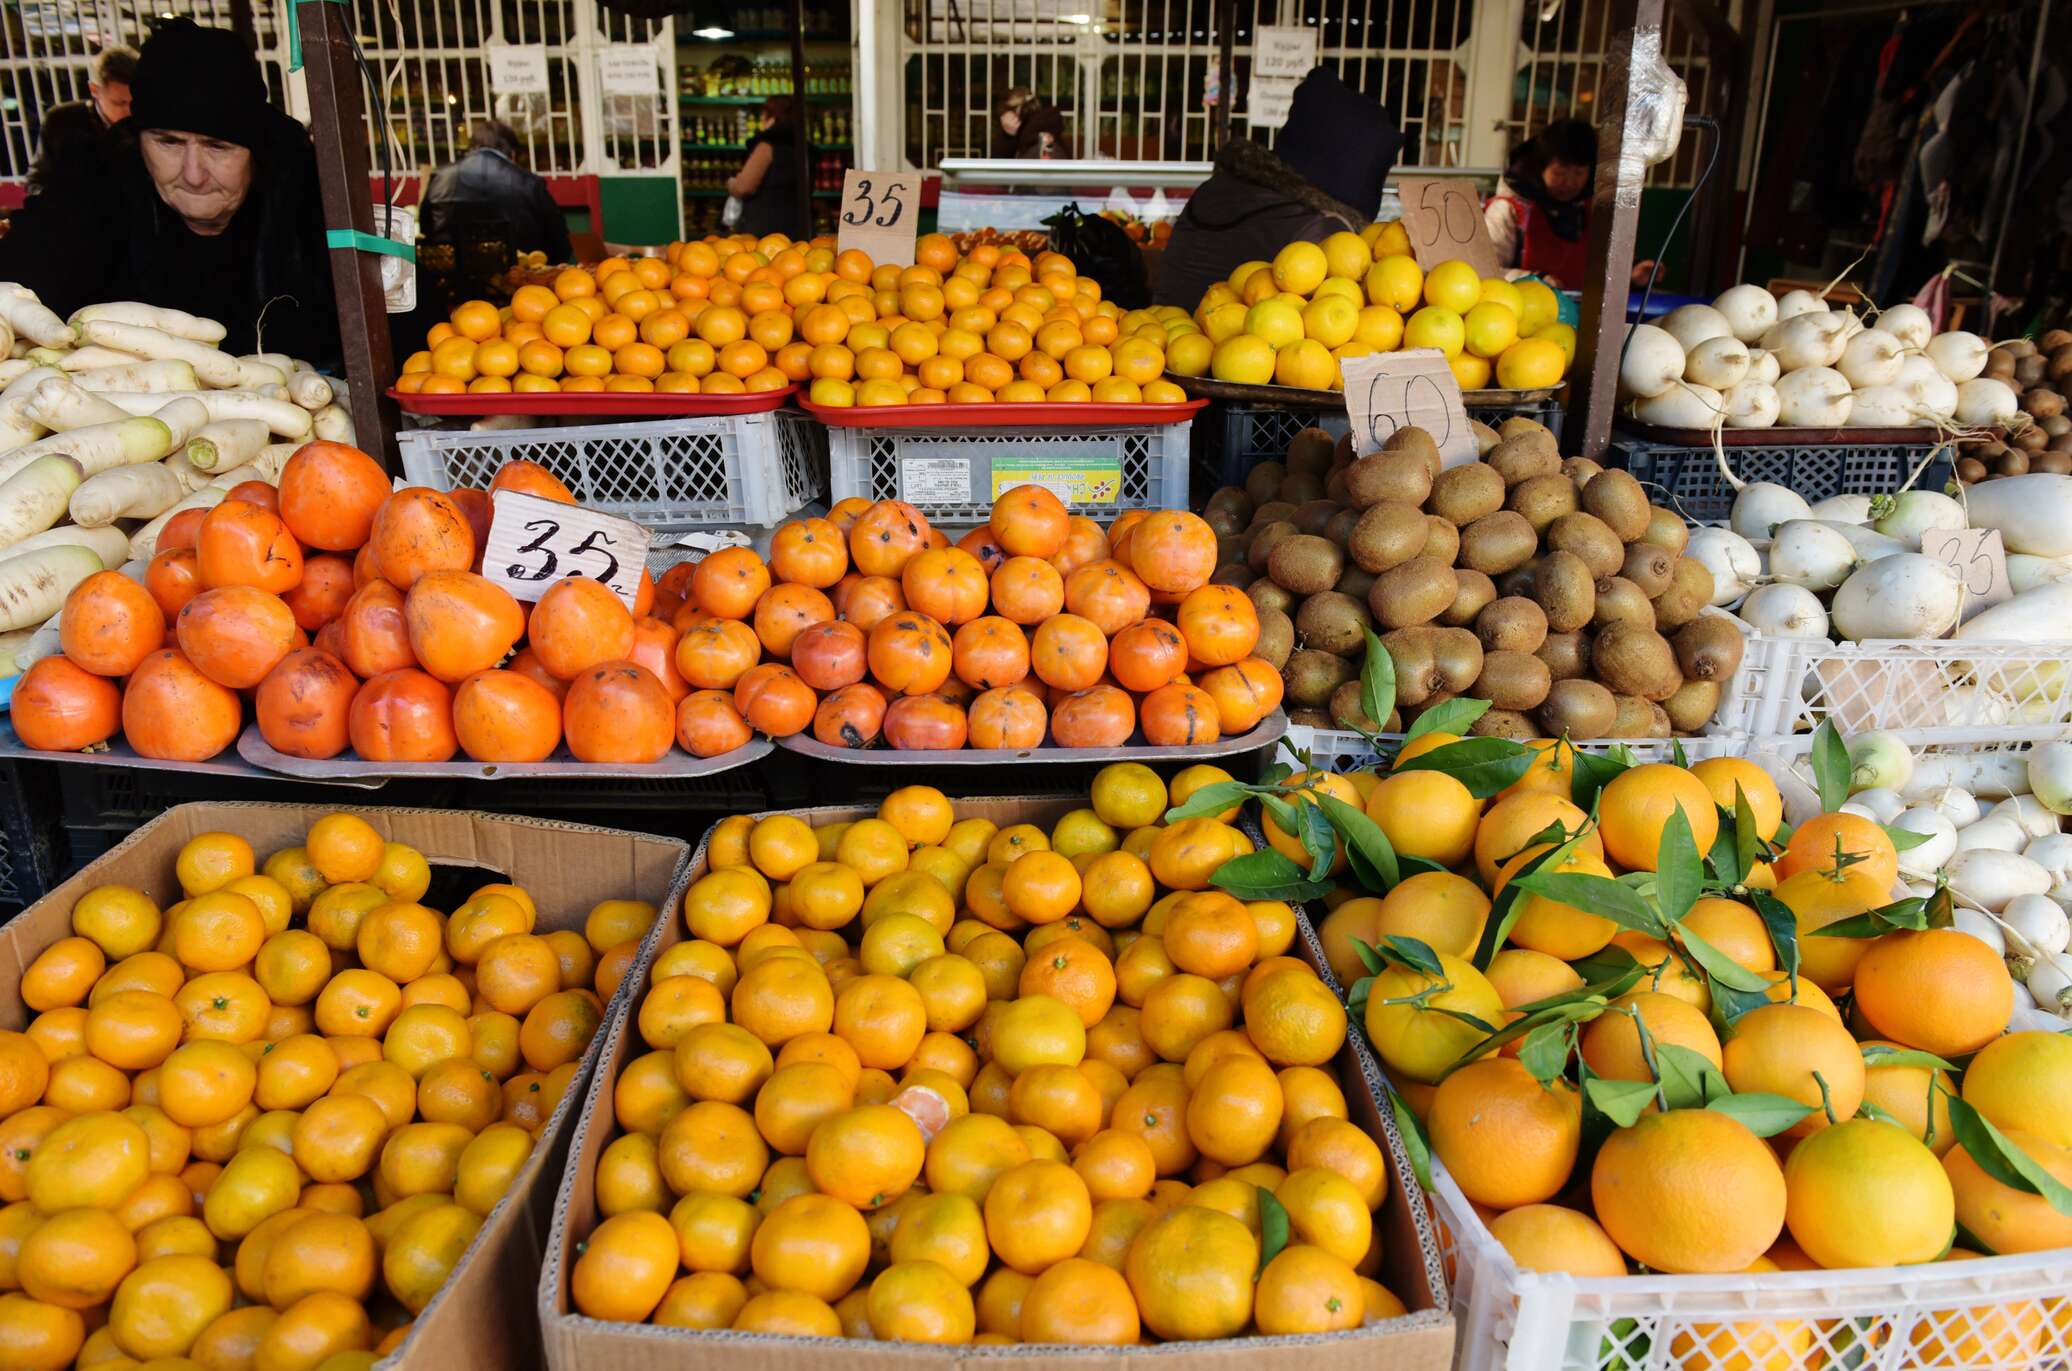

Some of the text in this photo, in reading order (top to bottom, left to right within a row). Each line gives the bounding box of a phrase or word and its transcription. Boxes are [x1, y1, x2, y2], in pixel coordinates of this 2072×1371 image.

[842, 179, 908, 227] 35
[1420, 182, 1477, 247] 50
[1368, 372, 1451, 449] 60
[505, 519, 620, 584] 35
[1938, 528, 1997, 596] 35
